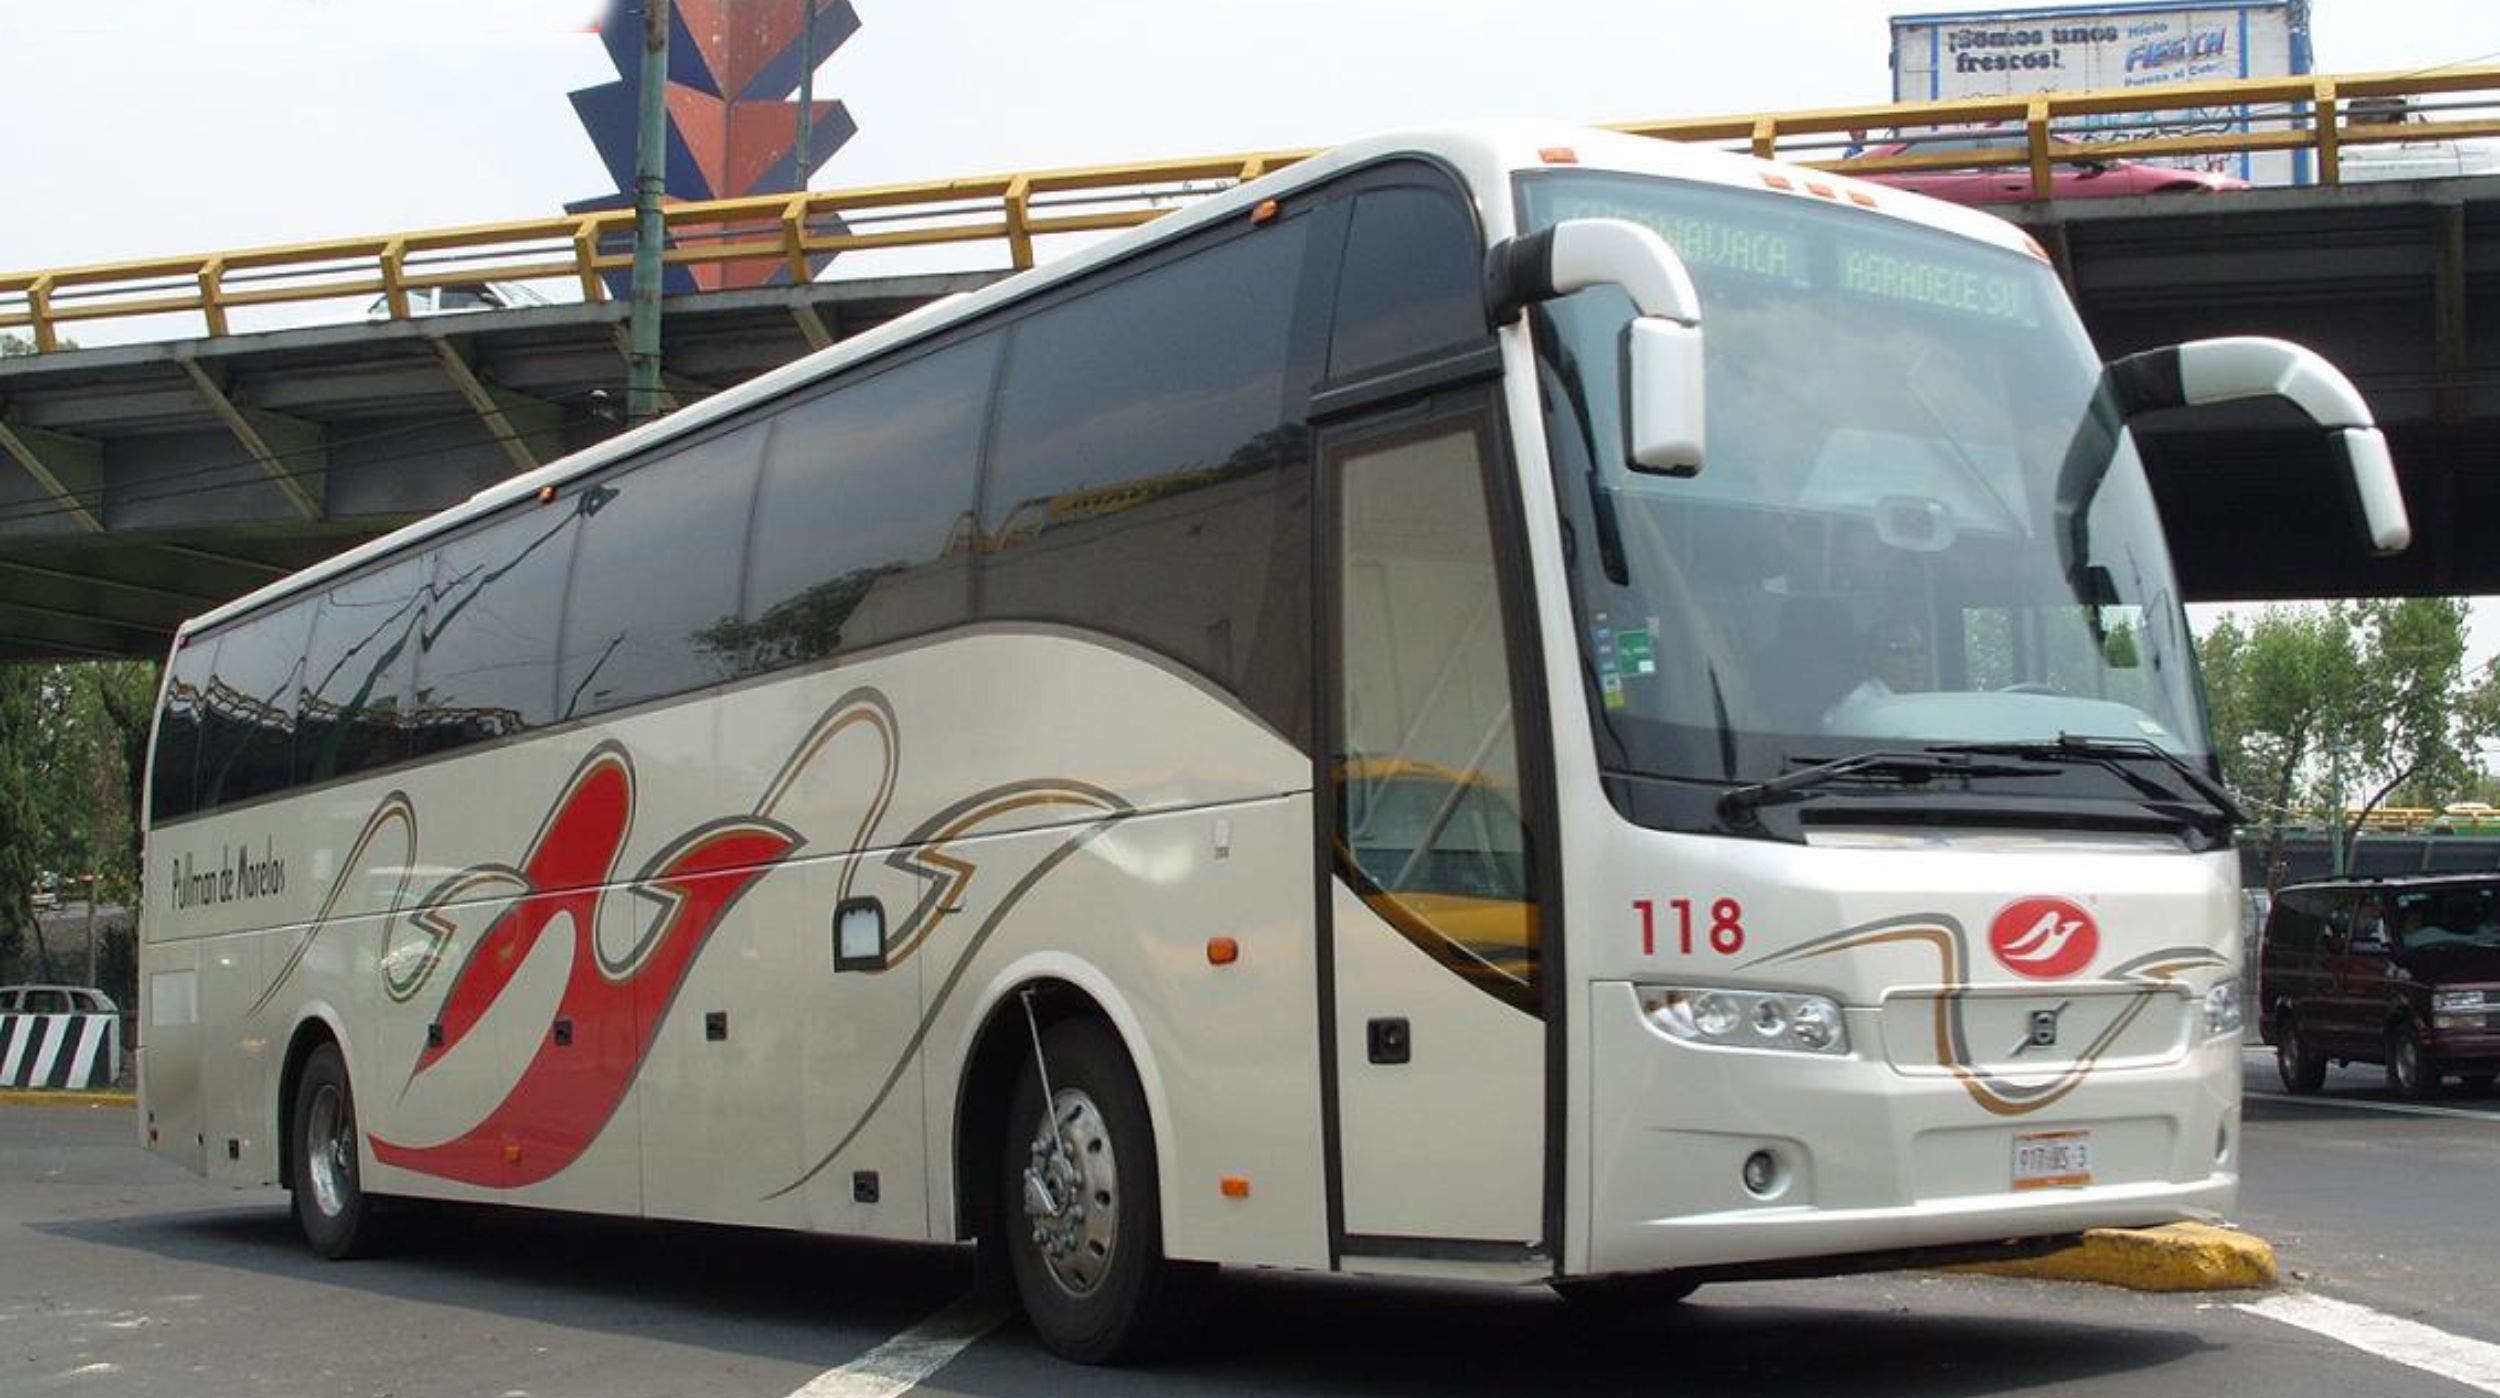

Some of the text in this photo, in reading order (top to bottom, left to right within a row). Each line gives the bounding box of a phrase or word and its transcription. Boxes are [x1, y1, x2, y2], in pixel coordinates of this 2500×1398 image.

[2052, 25, 2118, 44] unos
[1956, 49, 2061, 73] frescos!
[172, 834, 285, 911] Pullman de Morelos
[1632, 898, 1745, 955] 118
